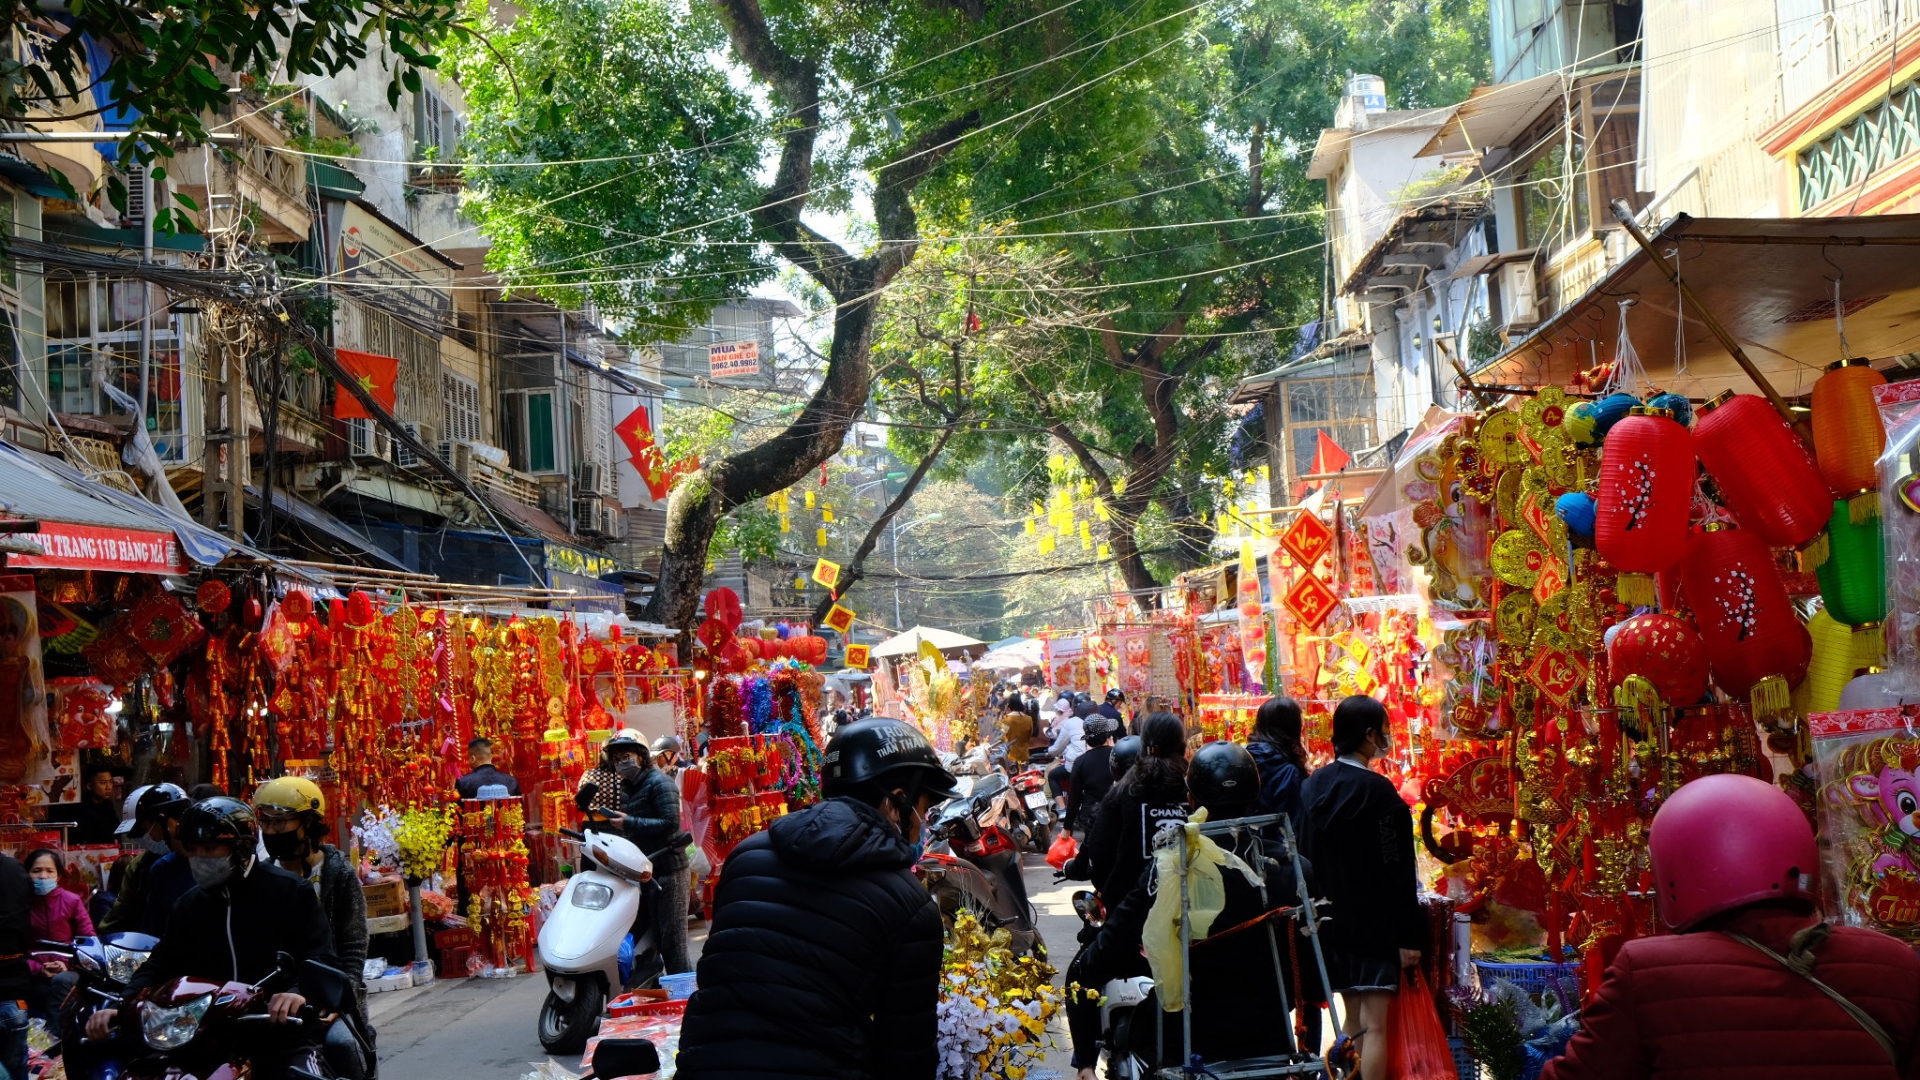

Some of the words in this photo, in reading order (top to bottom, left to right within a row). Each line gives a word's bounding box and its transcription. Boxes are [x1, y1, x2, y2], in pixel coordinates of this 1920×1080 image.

[711, 345, 735, 354] MUA
[55, 534, 96, 559] TRANG
[97, 539, 117, 560] 11B
[120, 535, 148, 563] HÀNG
[150, 538, 165, 564] MÃ
[1295, 522, 1323, 551] Vạn
